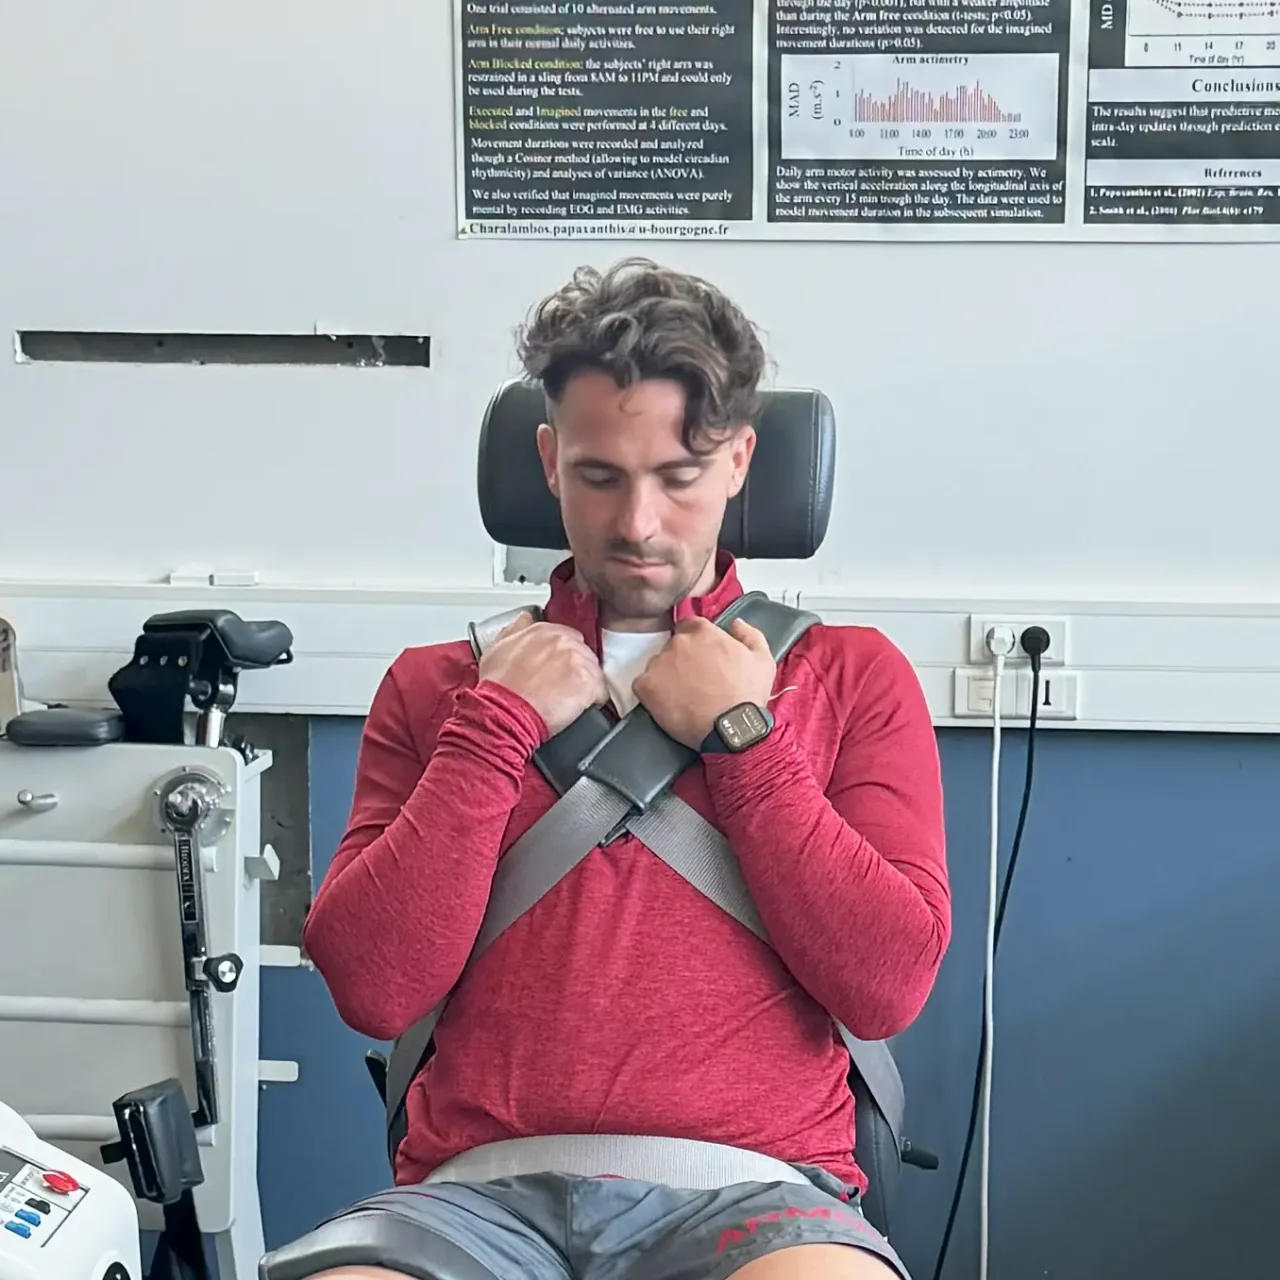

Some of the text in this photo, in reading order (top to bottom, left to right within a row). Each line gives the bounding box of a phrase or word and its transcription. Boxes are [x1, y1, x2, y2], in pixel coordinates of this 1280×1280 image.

[777, 11, 796, 23] than
[800, 11, 831, 23] during
[835, 11, 849, 23] the
[853, 11, 876, 23] Arm
[880, 11, 900, 23] free
[926, 23, 967, 36] detected
[971, 23, 985, 36] for
[1006, 23, 1052, 36] imagined
[777, 38, 826, 50] movement
[893, 55, 916, 64] Arm
[1192, 79, 1280, 92] Conclusions
[471, 138, 522, 150] Movement
[597, 138, 637, 150] recorded
[899, 146, 924, 157] Time
[926, 146, 936, 157] of
[939, 146, 958, 157] day
[777, 167, 1046, 180] Daily arm motor activity was assessed by actimetry. We
[822, 180, 858, 193] vertical
[951, 180, 966, 193] the
[968, 180, 1027, 193] longitudinal
[1030, 180, 1049, 193] axis
[1052, 180, 1063, 193] of
[473, 189, 489, 202] We
[513, 189, 549, 202] verified
[552, 189, 569, 202] that
[619, 189, 673, 202] movements
[677, 189, 699, 202] were
[702, 189, 732, 202] purely
[815, 193, 840, 206] every
[845, 193, 856, 206] 15
[914, 193, 930, 206] the
[933, 193, 952, 206] day.
[956, 193, 974, 206] The
[977, 193, 998, 206] data
[1001, 193, 1024, 206] were
[1027, 193, 1050, 206] used
[1053, 193, 1062, 206] to
[507, 204, 518, 216] by
[597, 204, 614, 216] and
[617, 204, 642, 216] EMG
[776, 206, 805, 218] model
[934, 206, 987, 218] subsequent
